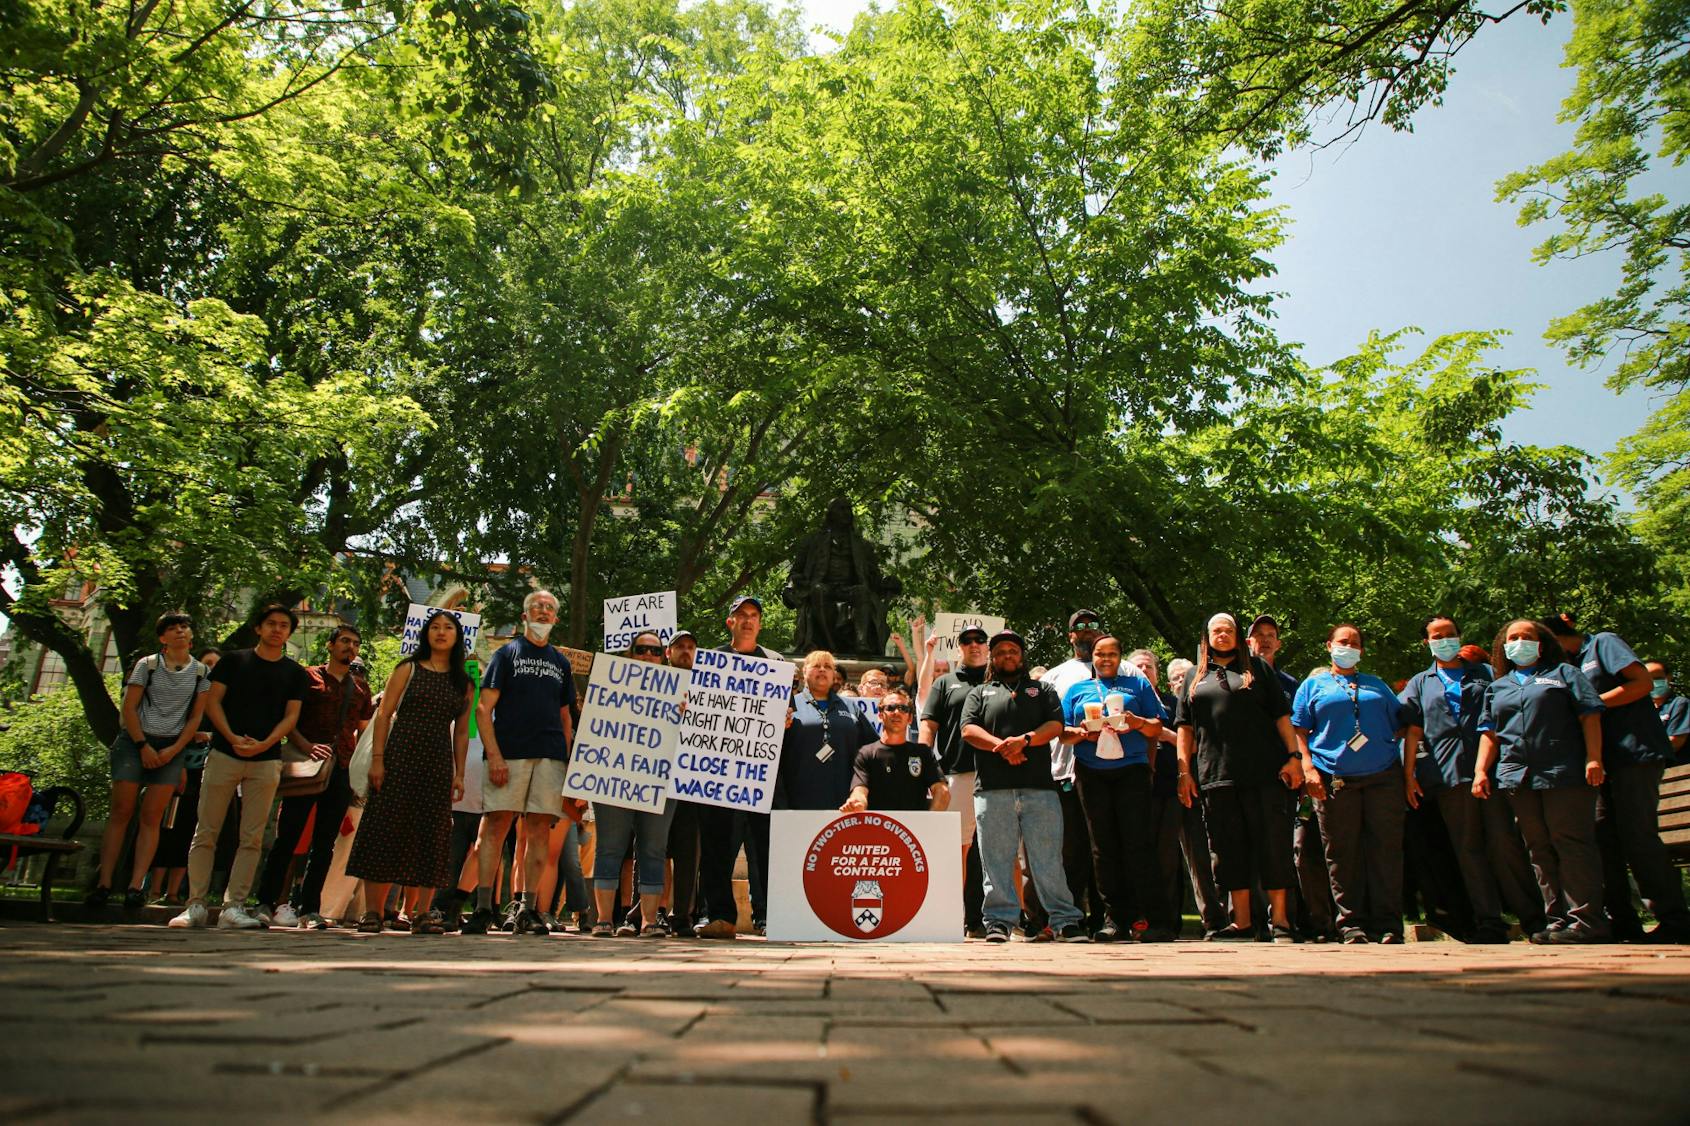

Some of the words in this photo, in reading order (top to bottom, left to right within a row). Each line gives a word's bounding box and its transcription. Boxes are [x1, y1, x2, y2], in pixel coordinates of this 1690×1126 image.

[606, 599, 630, 614] WE
[636, 595, 665, 610] ARE
[620, 613, 650, 630] ALL
[695, 650, 728, 669] END
[732, 656, 776, 676] TWO-
[608, 660, 680, 696] UPENN
[690, 668, 721, 689] TIER
[726, 676, 760, 695] RATE
[763, 682, 791, 700] PAY
[588, 683, 682, 725] TEAMSTERS
[688, 690, 706, 706] WE
[707, 693, 738, 712] HAVE
[742, 697, 768, 716] THE
[590, 718, 662, 749] UNITED
[682, 710, 722, 731] RIGHT
[724, 716, 755, 737] NOT
[757, 720, 776, 739] TO
[679, 731, 718, 751] WORK
[720, 737, 744, 757] FOR
[746, 740, 778, 761] LESS
[575, 743, 609, 768] FOR
[612, 753, 625, 770] A
[631, 754, 671, 780] FAIR
[678, 753, 730, 776] CLOSE
[735, 760, 768, 782] THE
[567, 772, 666, 807] CONTRACT
[674, 777, 725, 801] WAGE
[726, 784, 764, 807] GAP
[806, 853, 818, 872] NO
[864, 815, 882, 826] NO
[883, 820, 925, 873] GIVEBACKS
[842, 845, 890, 855] UNITED
[830, 856, 857, 866] FOR
[859, 856, 869, 866] A
[871, 857, 901, 867] FAIR
[833, 866, 902, 876] CONTRACT
